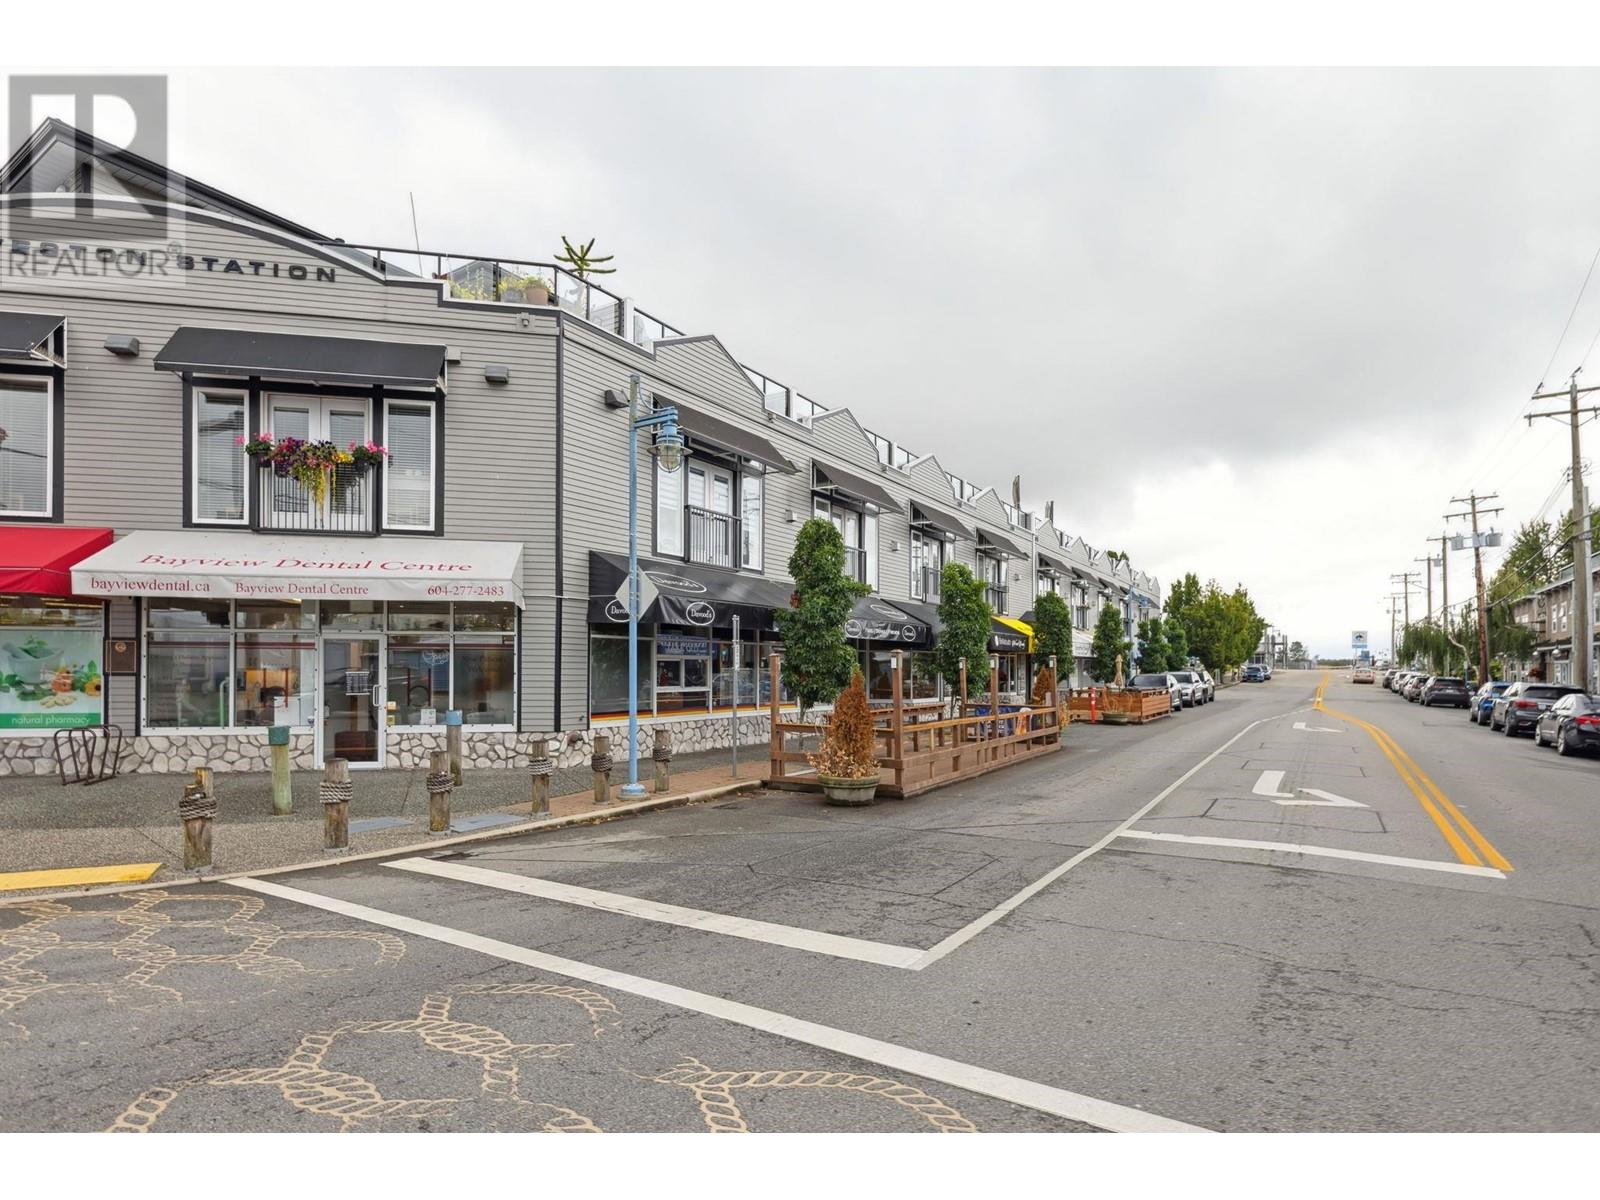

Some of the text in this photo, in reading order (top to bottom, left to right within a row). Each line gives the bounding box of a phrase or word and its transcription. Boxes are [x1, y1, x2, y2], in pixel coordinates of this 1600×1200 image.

[0, 238, 337, 283] ESTON STATION
[139, 554, 473, 572] Bayview Dental Centre
[91, 577, 211, 594] bayviewdental.ca
[235, 582, 369, 597] Bayview Dental Centre
[427, 585, 504, 596] 604-277-2483
[11, 715, 90, 726] natural pharmacy
